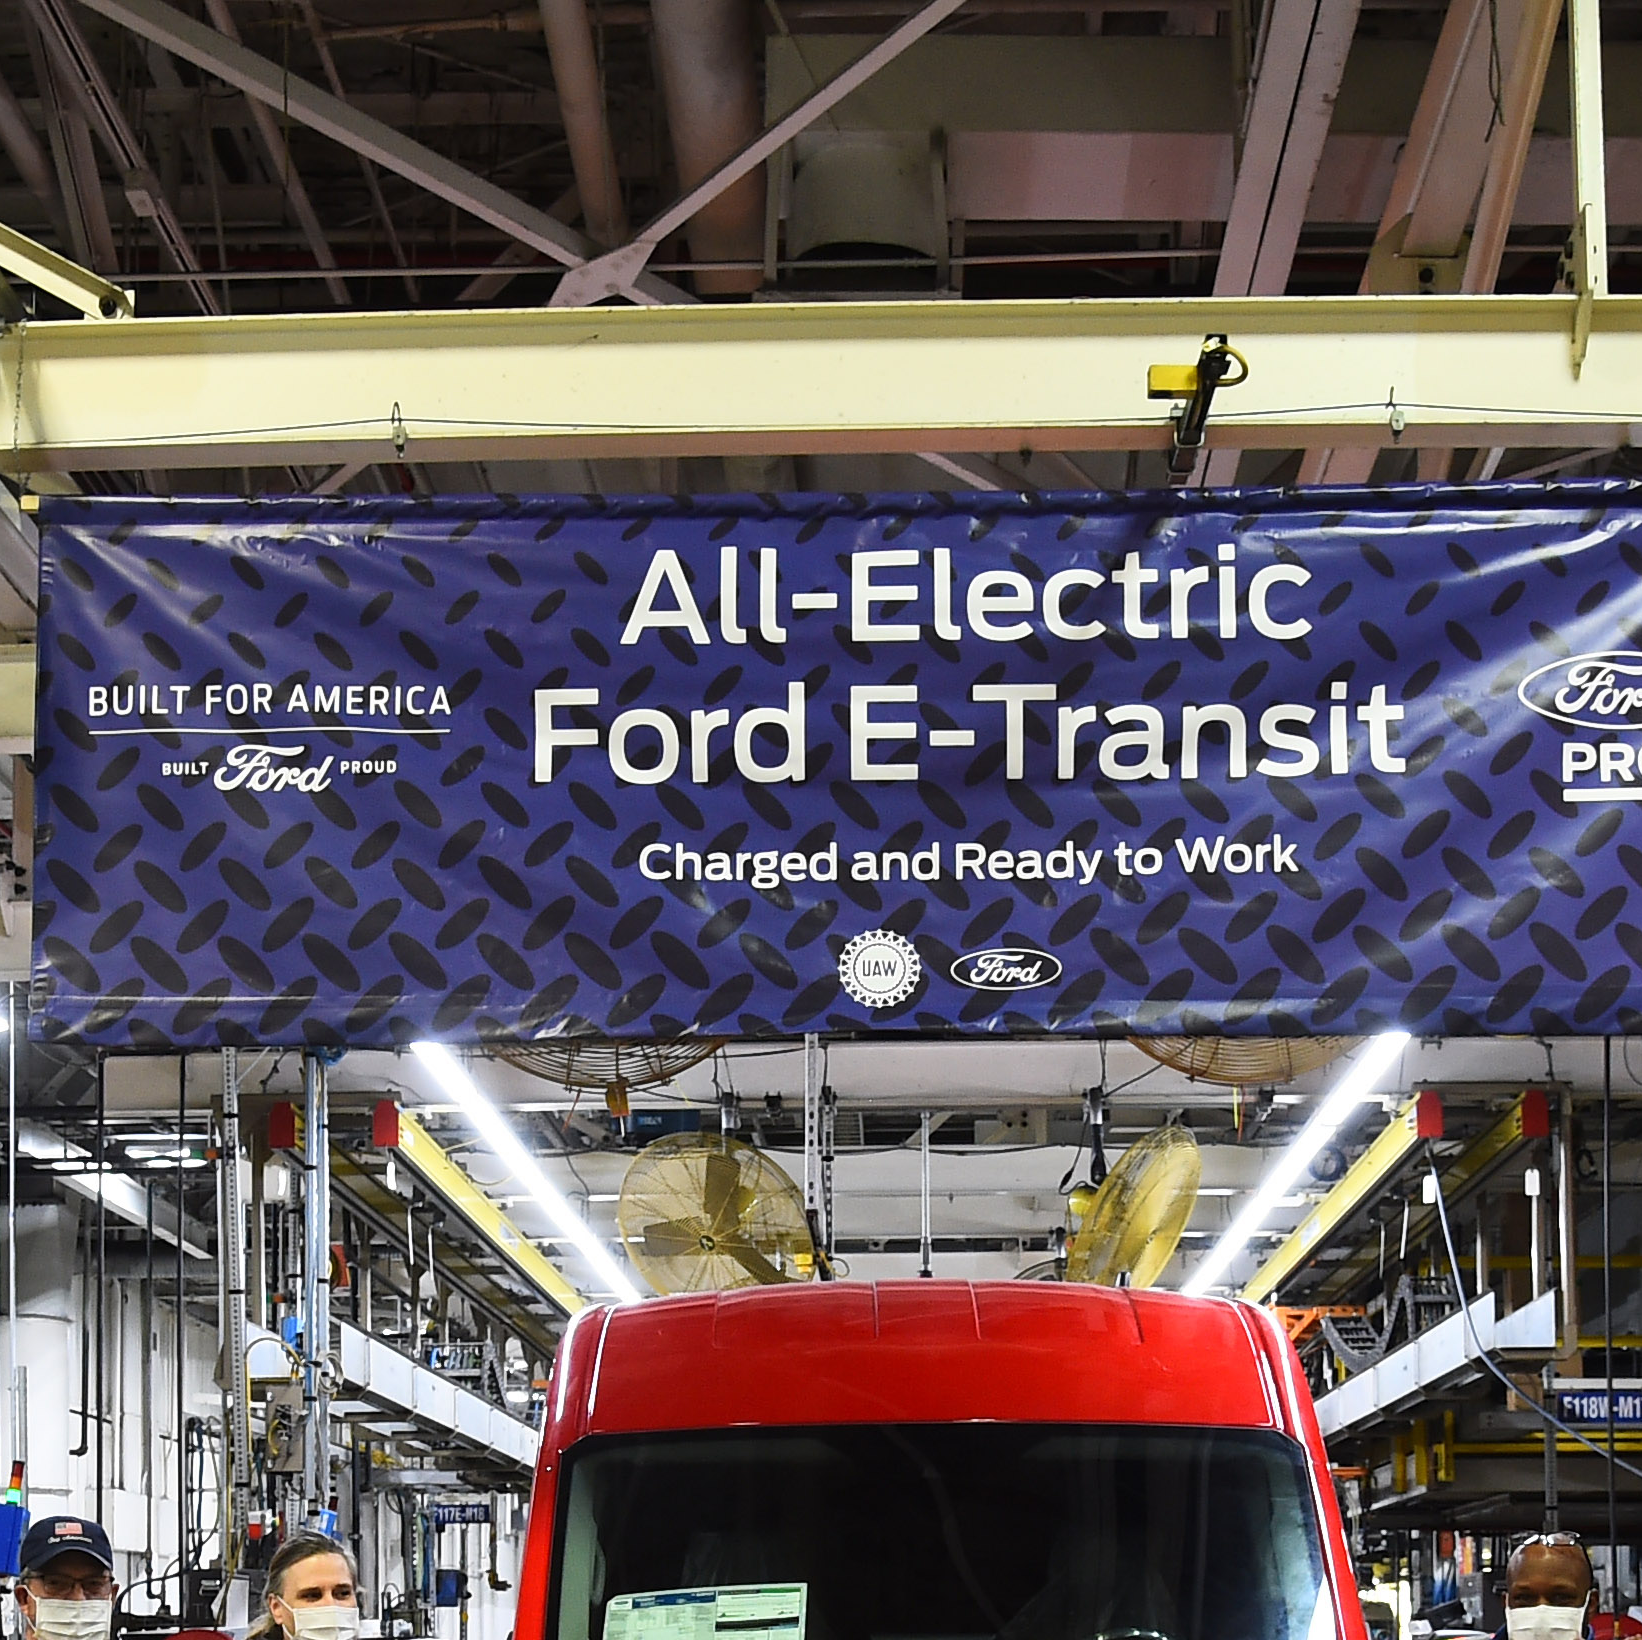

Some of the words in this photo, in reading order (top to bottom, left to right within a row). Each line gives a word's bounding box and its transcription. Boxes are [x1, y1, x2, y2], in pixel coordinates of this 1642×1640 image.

[620, 542, 1314, 646] All-Electric
[87, 684, 191, 718] BUILT
[204, 682, 274, 717] FOR
[286, 683, 453, 717] AMERICA
[533, 680, 807, 786] Ford
[849, 680, 1408, 782] E-Transit
[161, 761, 210, 777] BUILT
[213, 743, 335, 793] Ford
[340, 759, 398, 775] PROUD
[638, 841, 839, 890] Charged
[850, 841, 941, 882] and
[954, 839, 1102, 886] Ready
[1112, 841, 1164, 877] to
[1173, 832, 1300, 876] Work
[861, 958, 898, 978] UAW
[969, 953, 1044, 983] Ford
